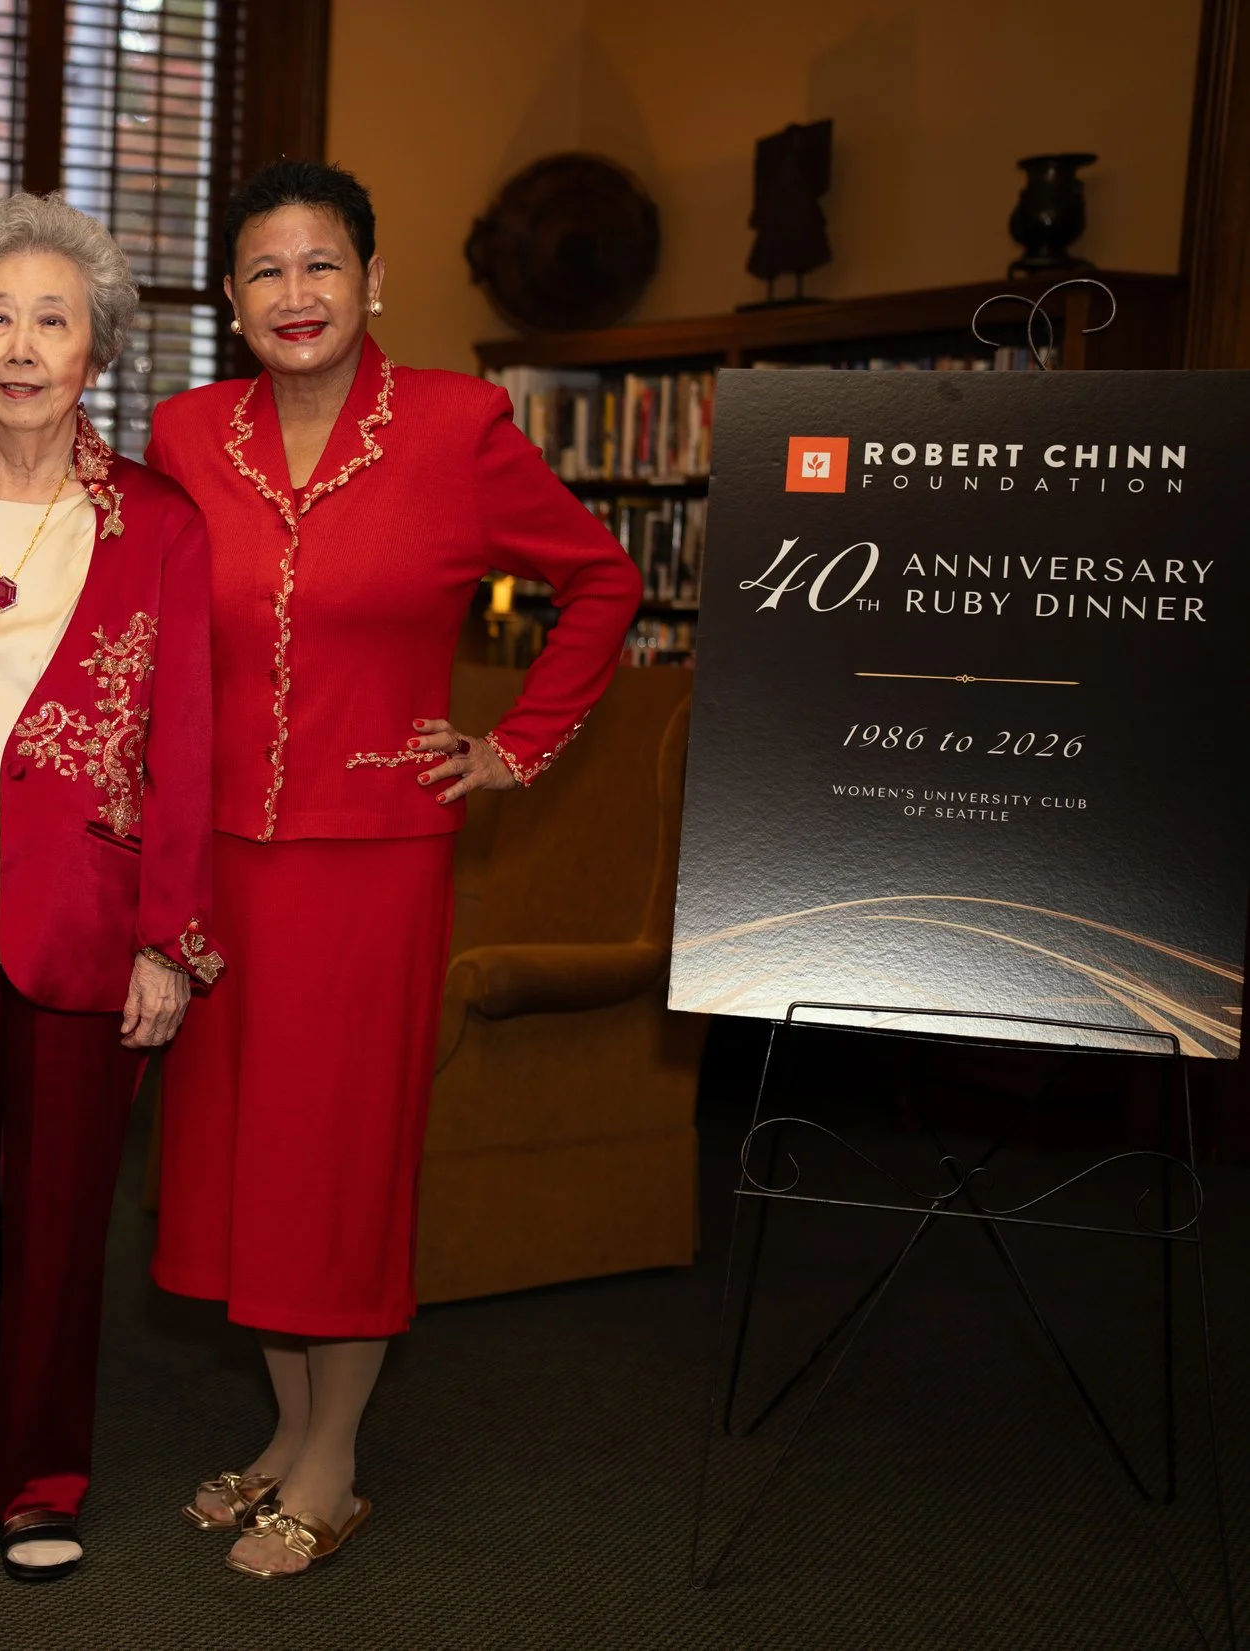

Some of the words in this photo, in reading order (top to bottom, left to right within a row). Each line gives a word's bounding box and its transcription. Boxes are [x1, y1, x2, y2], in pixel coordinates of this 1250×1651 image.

[863, 442, 1024, 468] ROBERT
[1043, 444, 1186, 469] CHINN
[862, 474, 1182, 494] FOUNDATION
[902, 553, 1214, 584] ANNIVERSARY
[906, 589, 1011, 616] RUBY
[1035, 593, 1207, 622] DINNER
[843, 723, 927, 750] 1986
[939, 731, 973, 753] to
[986, 731, 1086, 758] 2026
[832, 784, 915, 800] WOMEN'S
[923, 790, 1032, 806] UNIVERSITY
[1041, 796, 1087, 809] CLUB
[903, 805, 926, 817] OF
[934, 807, 1009, 822] SEATTLE
